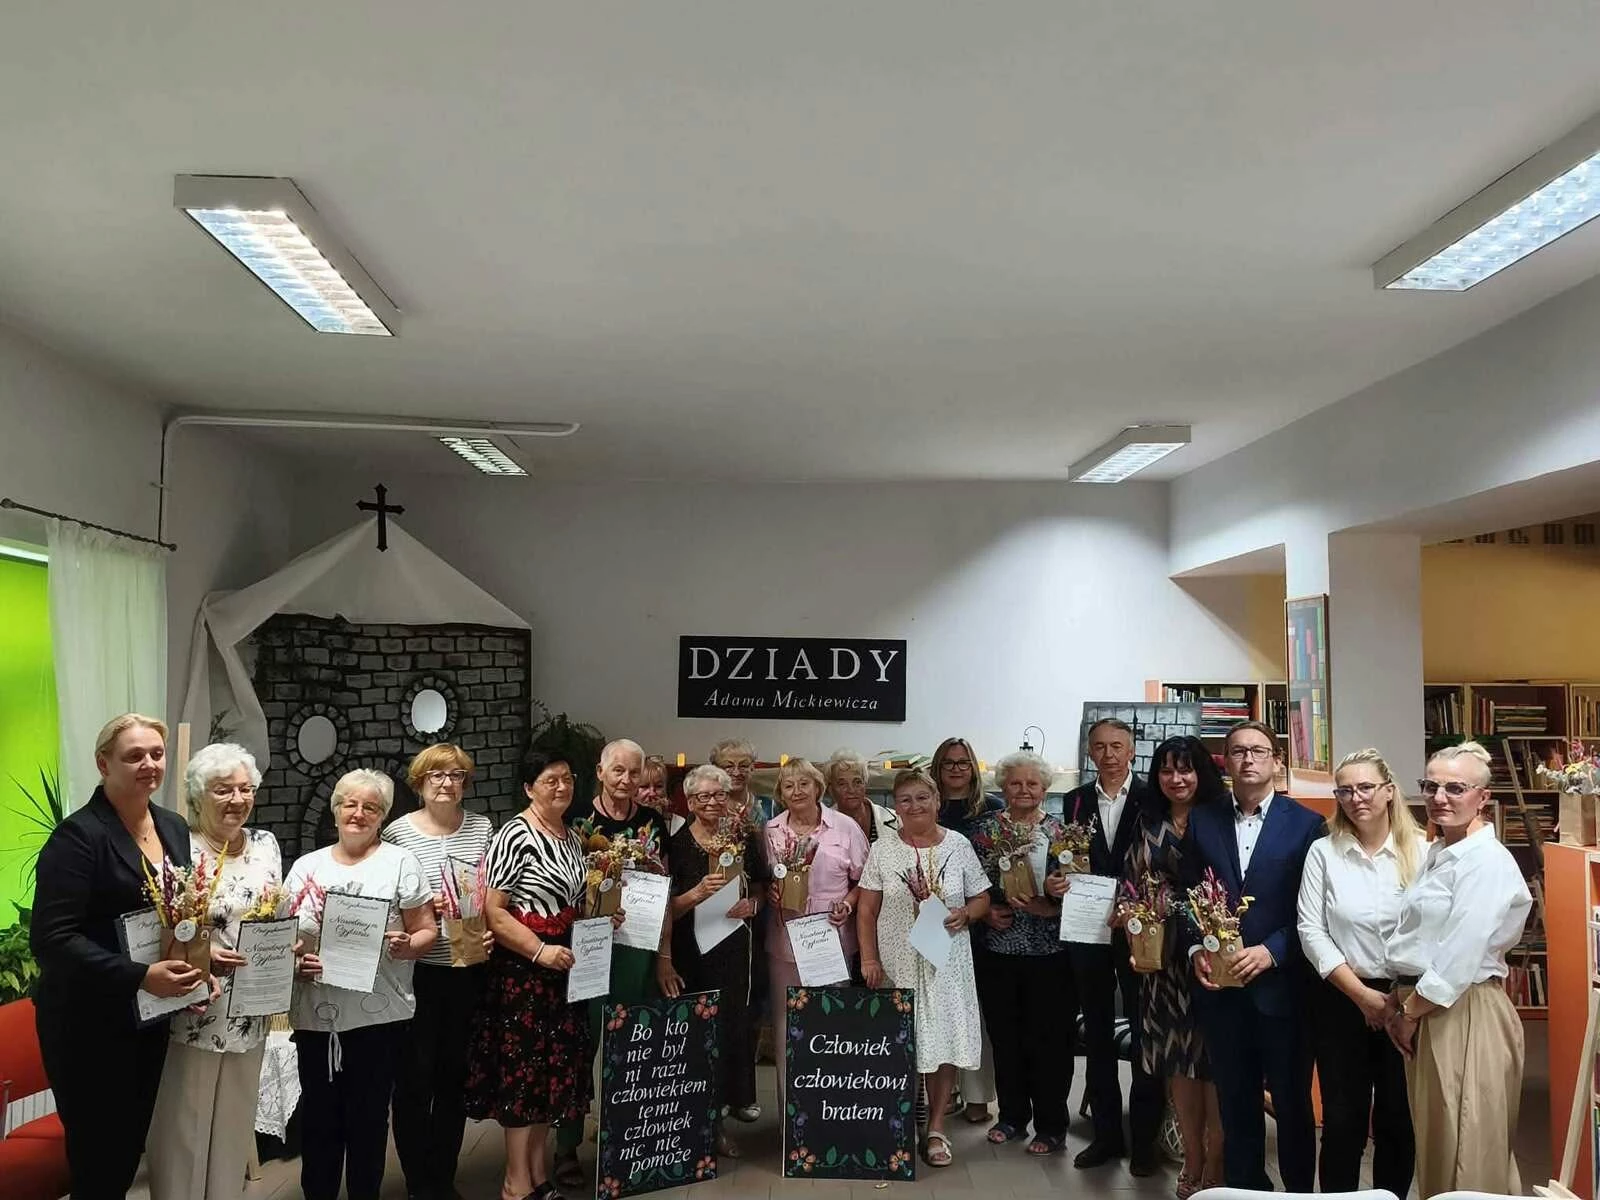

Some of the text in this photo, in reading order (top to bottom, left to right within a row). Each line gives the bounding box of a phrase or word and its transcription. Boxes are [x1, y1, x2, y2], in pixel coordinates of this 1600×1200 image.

[688, 647, 899, 682] DZIADY
[704, 688, 878, 710] Adama Mickiewicza
[630, 1017, 689, 1043] Bo kto
[626, 1038, 686, 1063] nie był
[809, 1033, 892, 1058] Człowiek
[625, 1062, 687, 1084] ni razu
[794, 1068, 908, 1092] człowiekowi
[611, 1078, 707, 1105] człowiekiem
[638, 1101, 679, 1121] temu
[822, 1100, 884, 1121] bratem
[624, 1112, 693, 1142] człowiek
[619, 1133, 681, 1162] nic nie
[629, 1146, 691, 1179] pomoże
